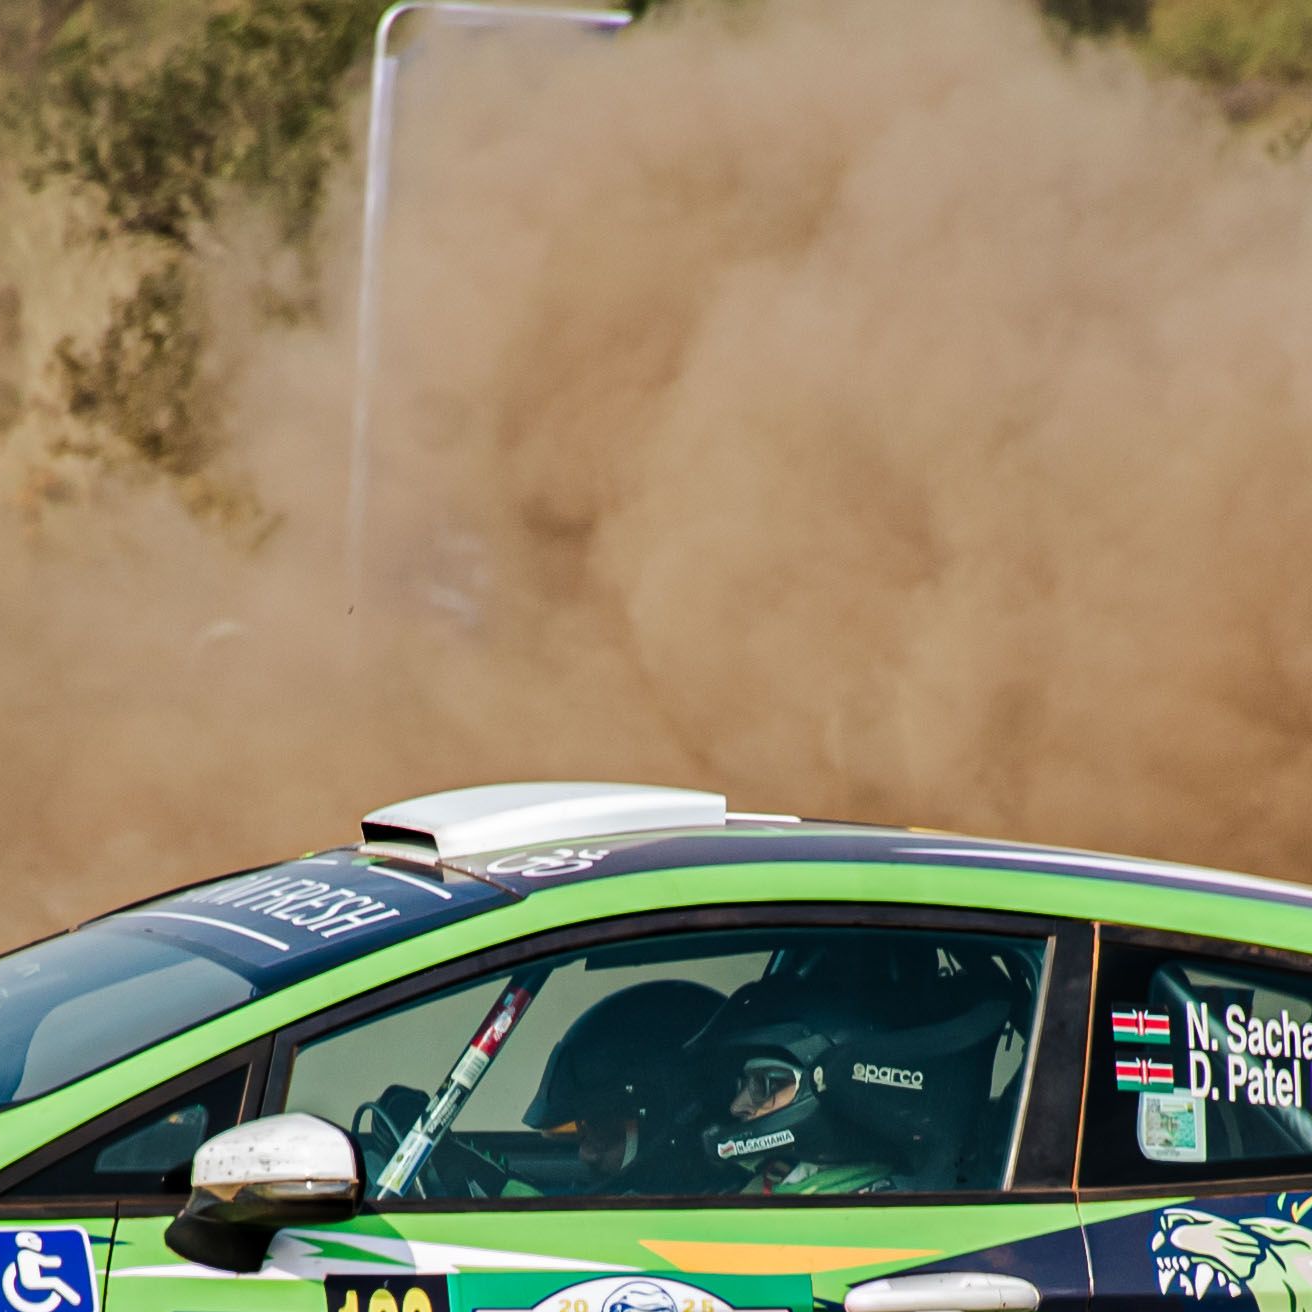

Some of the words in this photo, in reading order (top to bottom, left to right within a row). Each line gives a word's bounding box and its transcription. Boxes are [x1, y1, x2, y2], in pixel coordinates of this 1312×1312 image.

[233, 879, 400, 939] FRESH
[1186, 1001, 1218, 1052] N.
[1189, 1053, 1218, 1100] D.
[1227, 1056, 1302, 1108] Patel
